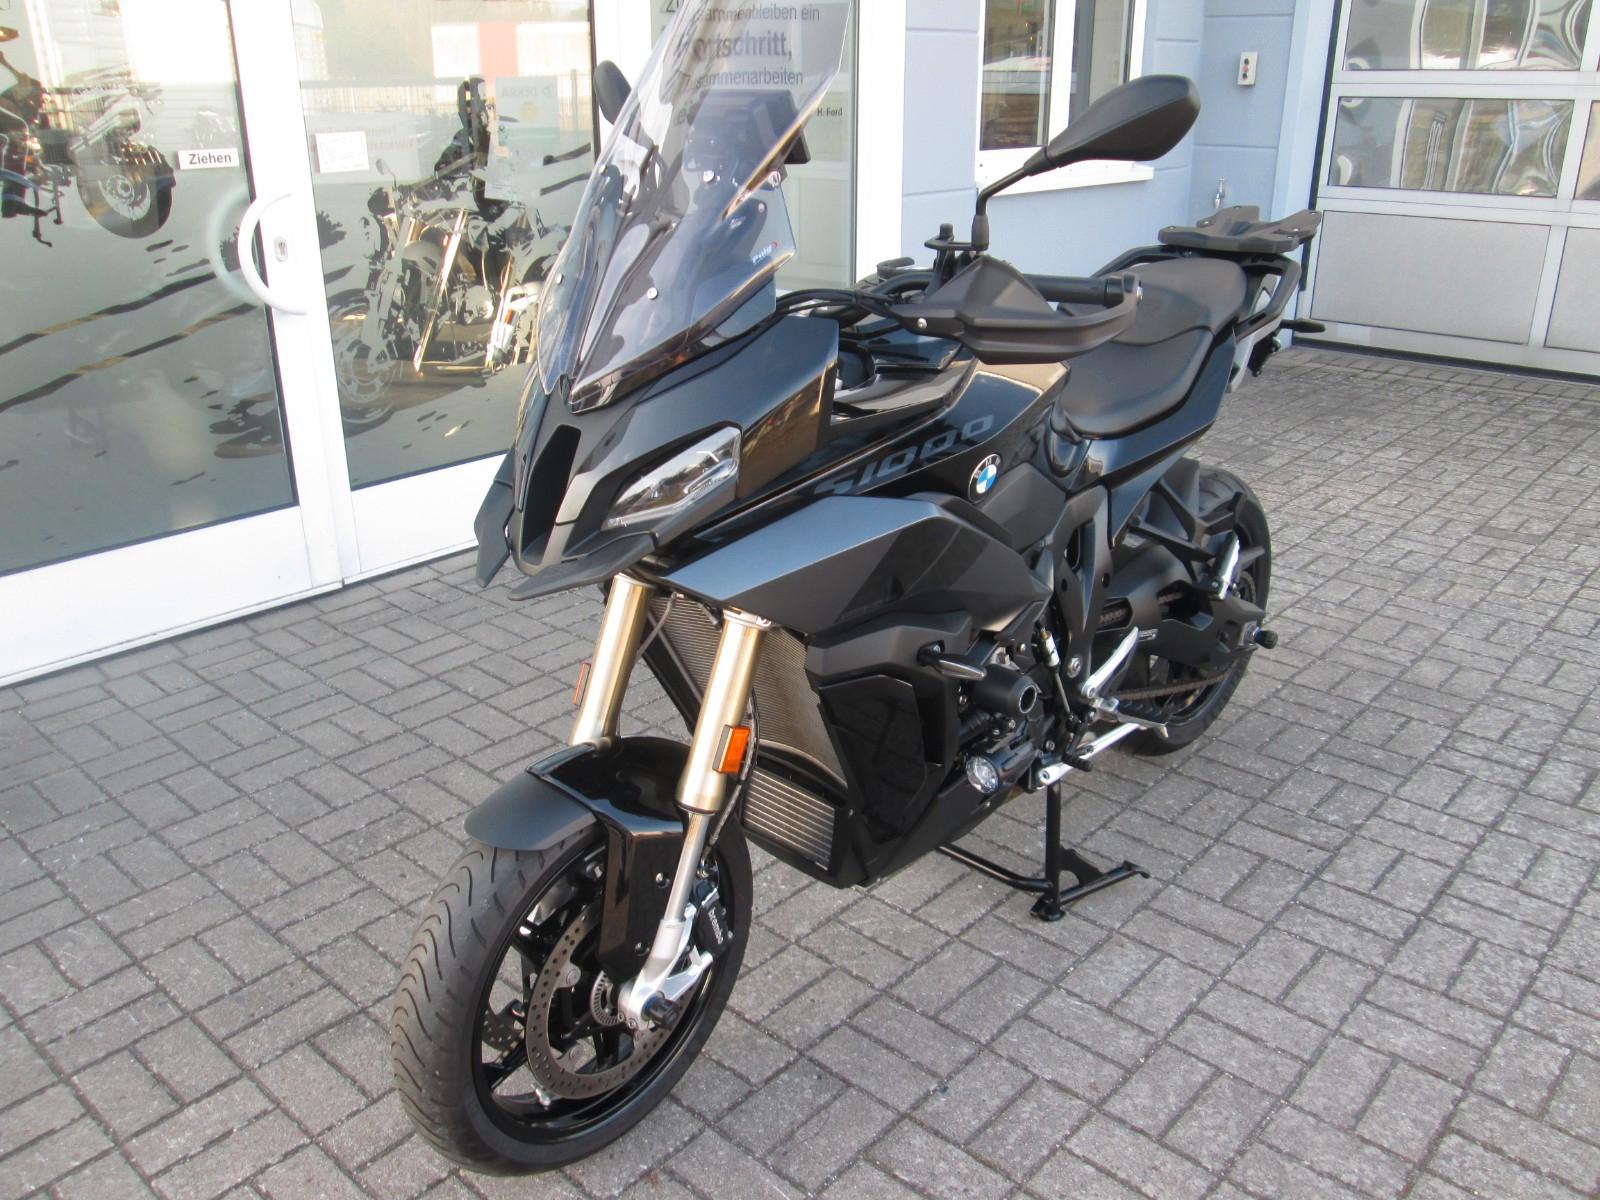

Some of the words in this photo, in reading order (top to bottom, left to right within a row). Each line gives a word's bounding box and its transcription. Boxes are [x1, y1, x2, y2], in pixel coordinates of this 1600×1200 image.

[801, 4, 820, 21] ein
[188, 152, 232, 166] Ziehen
[708, 908, 724, 945] brembo
